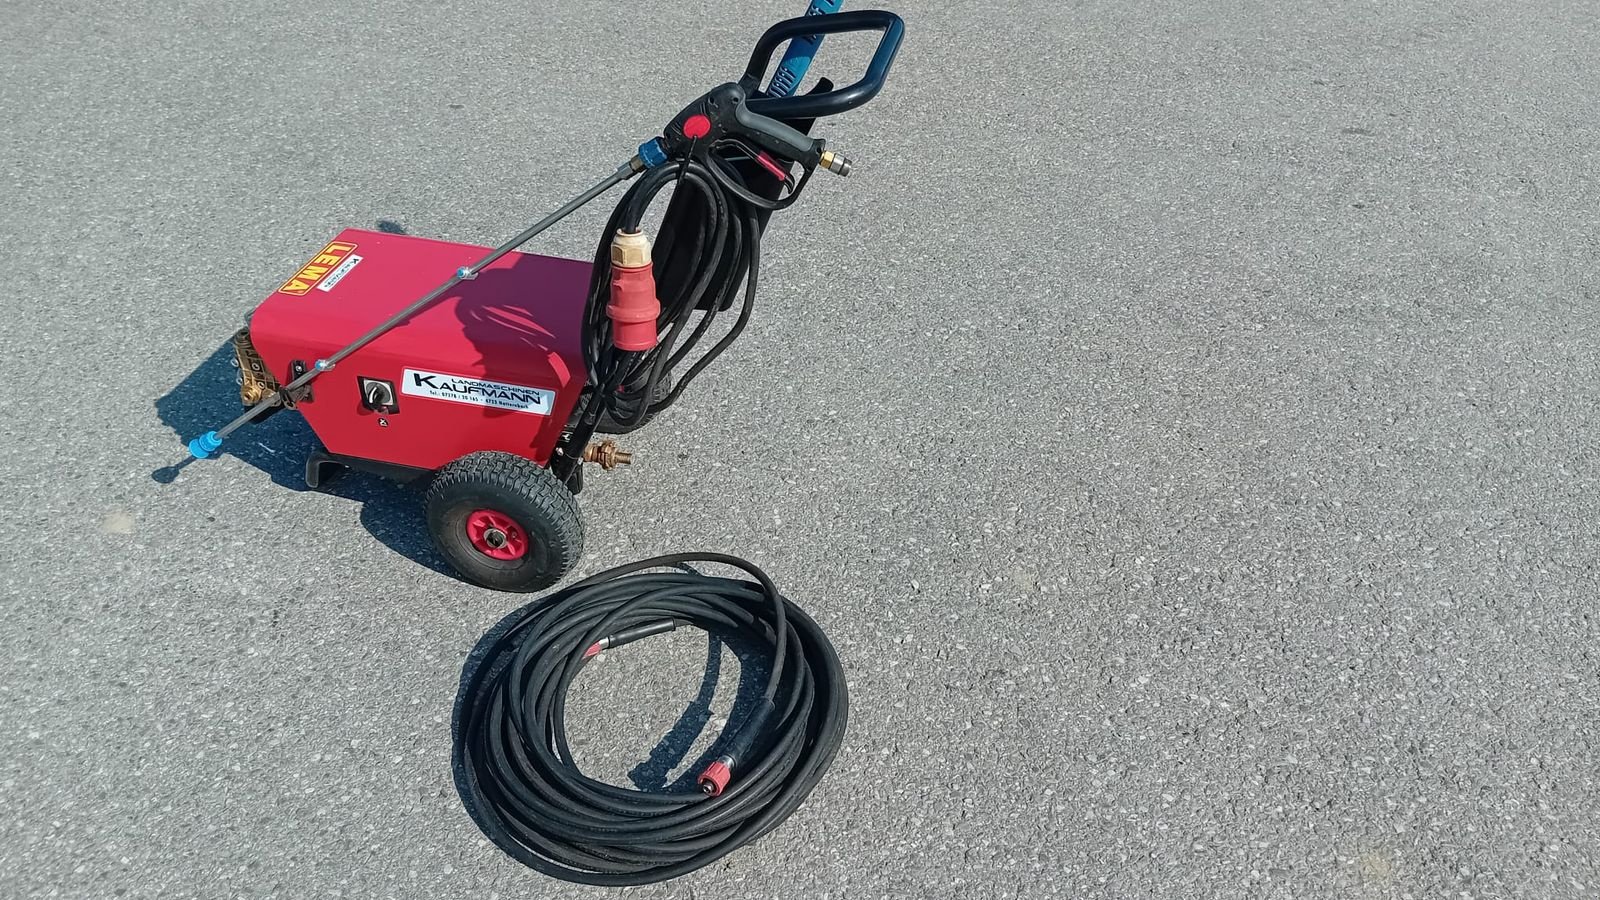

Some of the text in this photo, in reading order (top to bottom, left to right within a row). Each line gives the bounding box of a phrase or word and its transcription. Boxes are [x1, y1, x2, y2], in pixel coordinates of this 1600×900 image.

[281, 244, 353, 292] LEMA
[413, 373, 541, 405] KAUFMANN
[451, 378, 540, 396] LANDMASCHINEN
